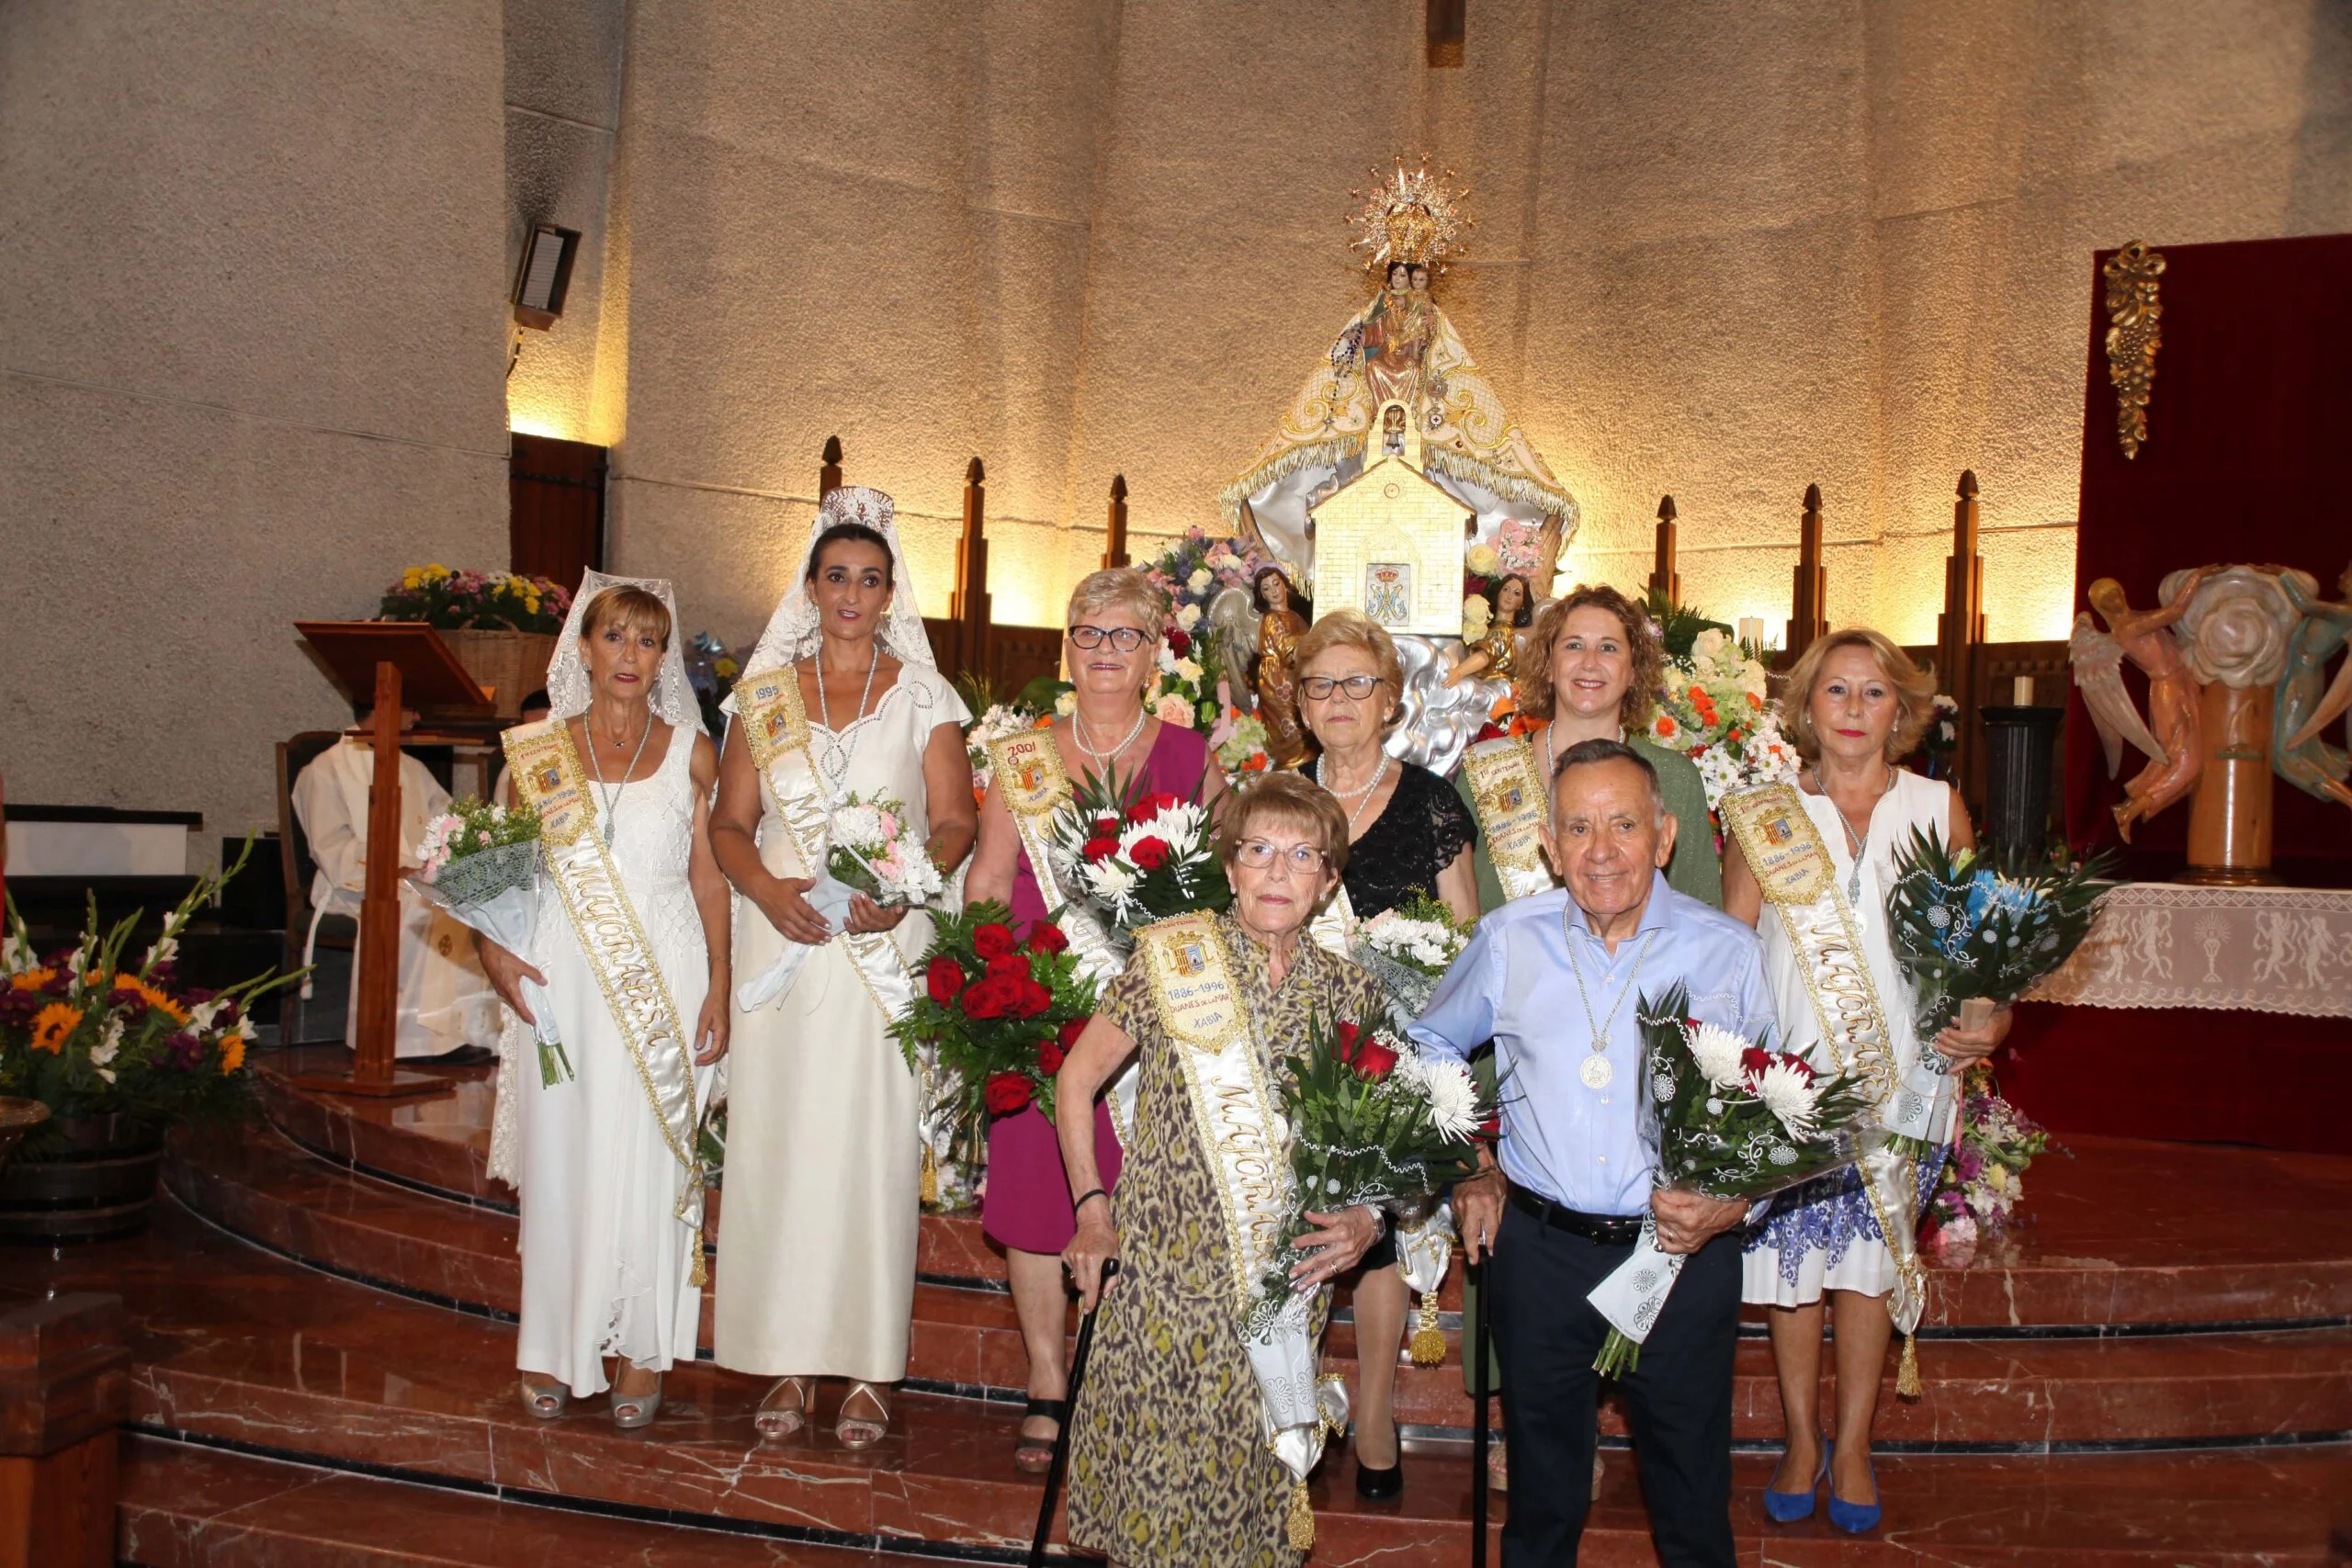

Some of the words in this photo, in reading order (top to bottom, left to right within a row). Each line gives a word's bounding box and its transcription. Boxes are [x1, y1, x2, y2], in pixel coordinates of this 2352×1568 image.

[755, 685, 780, 700] 1995
[1007, 740, 1037, 758] 2001
[1507, 835, 1531, 851] XABIA
[1762, 841, 1812, 866] 1886-1996
[1784, 868, 1810, 886] XABIA
[1168, 980, 1225, 1001] 1886-1996
[1169, 998, 1201, 1014] DUANES
[1193, 1011, 1223, 1029] XABIA
